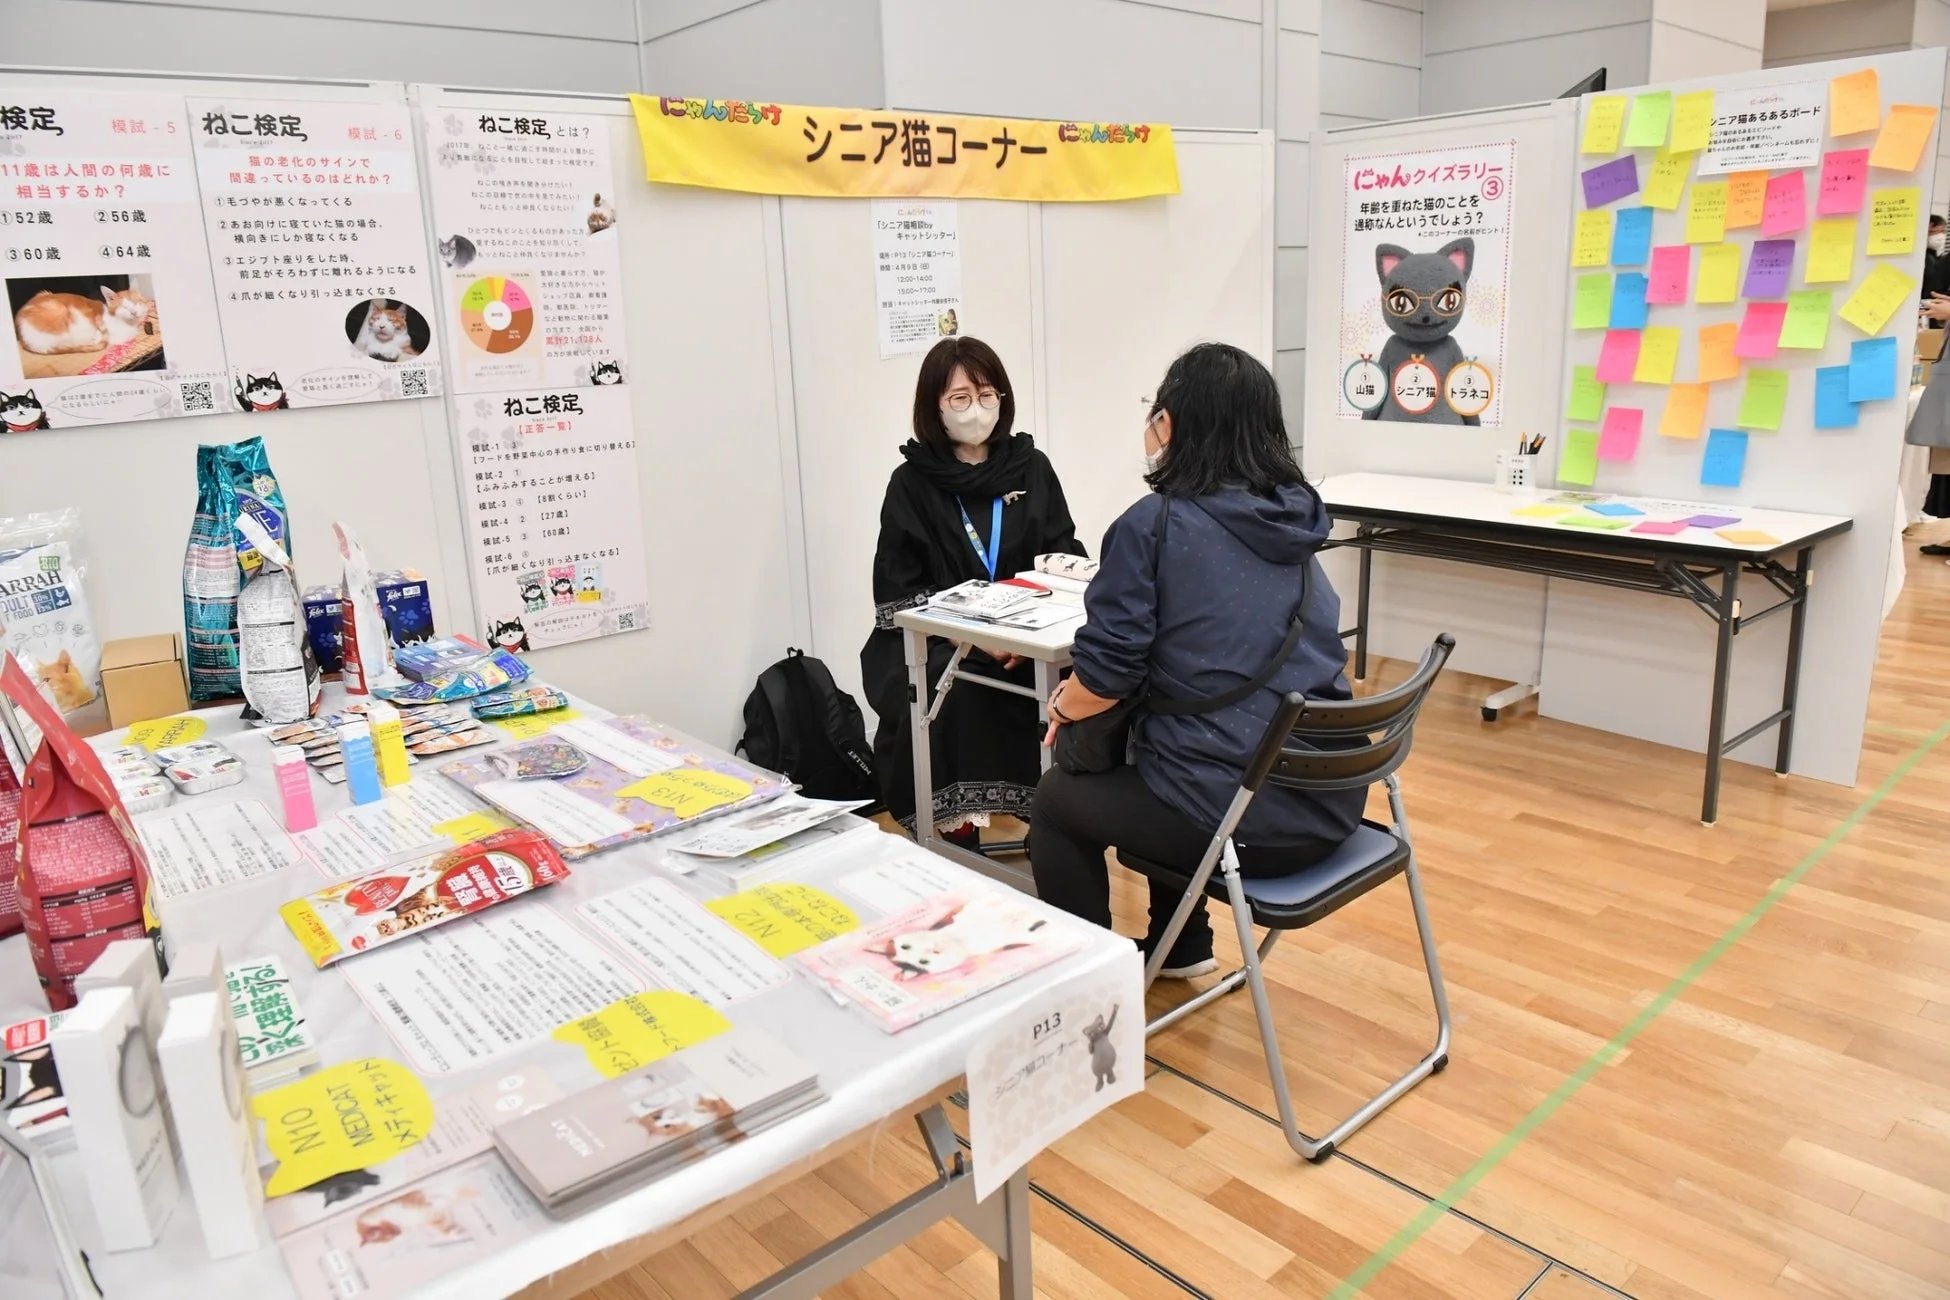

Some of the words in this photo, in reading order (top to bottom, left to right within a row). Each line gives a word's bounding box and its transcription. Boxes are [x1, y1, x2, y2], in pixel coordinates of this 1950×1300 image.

[202, 111, 308, 142] ねこ検定
[478, 114, 551, 140] ねこ検定
[556, 126, 591, 139] とは？
[803, 114, 1048, 170] シニア猫コーナー
[1058, 122, 1151, 144] にゃんだらけ
[1, 162, 171, 179] 11歳は人間の何歳に
[249, 155, 370, 168] 猫の老化のサインで
[229, 172, 391, 186] 間違っているのはどれか？
[1354, 162, 1503, 190] にゃんクイズラリー
[16, 184, 126, 200] 相当するか？
[1360, 194, 1480, 216] 年齢を重ねた猫のことを
[1354, 211, 1484, 232] 通称なんというでしょう？
[233, 232, 359, 244] 横向きにしか寝なくなる
[239, 265, 417, 280] 前足がそろわずに離れるようになる
[1355, 384, 1375, 396] 山猫
[1396, 385, 1437, 399] シニア猫
[1450, 386, 1490, 401] トラネコ
[503, 393, 584, 417] ねこ検定
[475, 471, 597, 494] 【ふみふみすることが増える】
[39, 556, 60, 571] BIO
[486, 547, 621, 577] 【爪が細くなり引っ込まなくなる】
[13, 608, 34, 620] FOOD
[1032, 1011, 1062, 1041] P13
[326, 1082, 375, 1148] MEDICAT
[280, 1106, 325, 1155] N10
